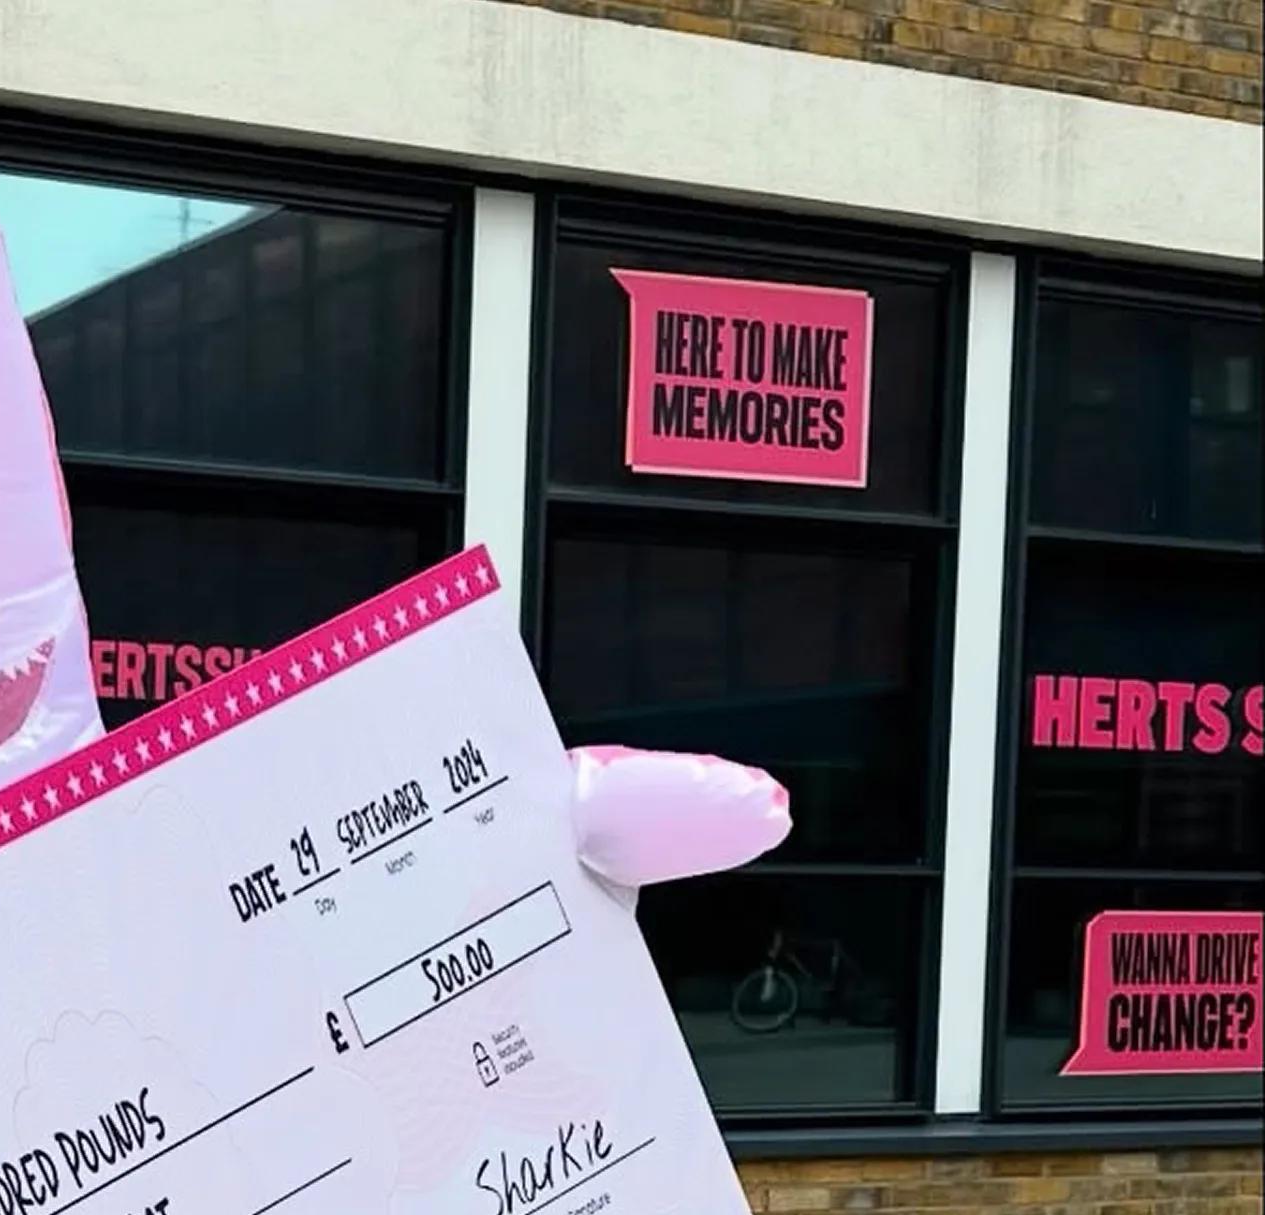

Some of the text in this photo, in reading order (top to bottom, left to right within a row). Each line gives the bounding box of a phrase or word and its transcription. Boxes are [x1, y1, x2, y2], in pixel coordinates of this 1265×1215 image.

[655, 310, 848, 391] HERE TO MAKE
[652, 383, 845, 451] MEMORIES
[1033, 675, 1232, 754] HERTS
[229, 738, 488, 922] DATE 29 SEPTEMBER 2024
[326, 938, 494, 1054] £ 500.00
[1112, 932, 1259, 985] WANNA DRIVE
[1107, 992, 1256, 1052] CHANGE?
[54, 1086, 166, 1189] POUNDS
